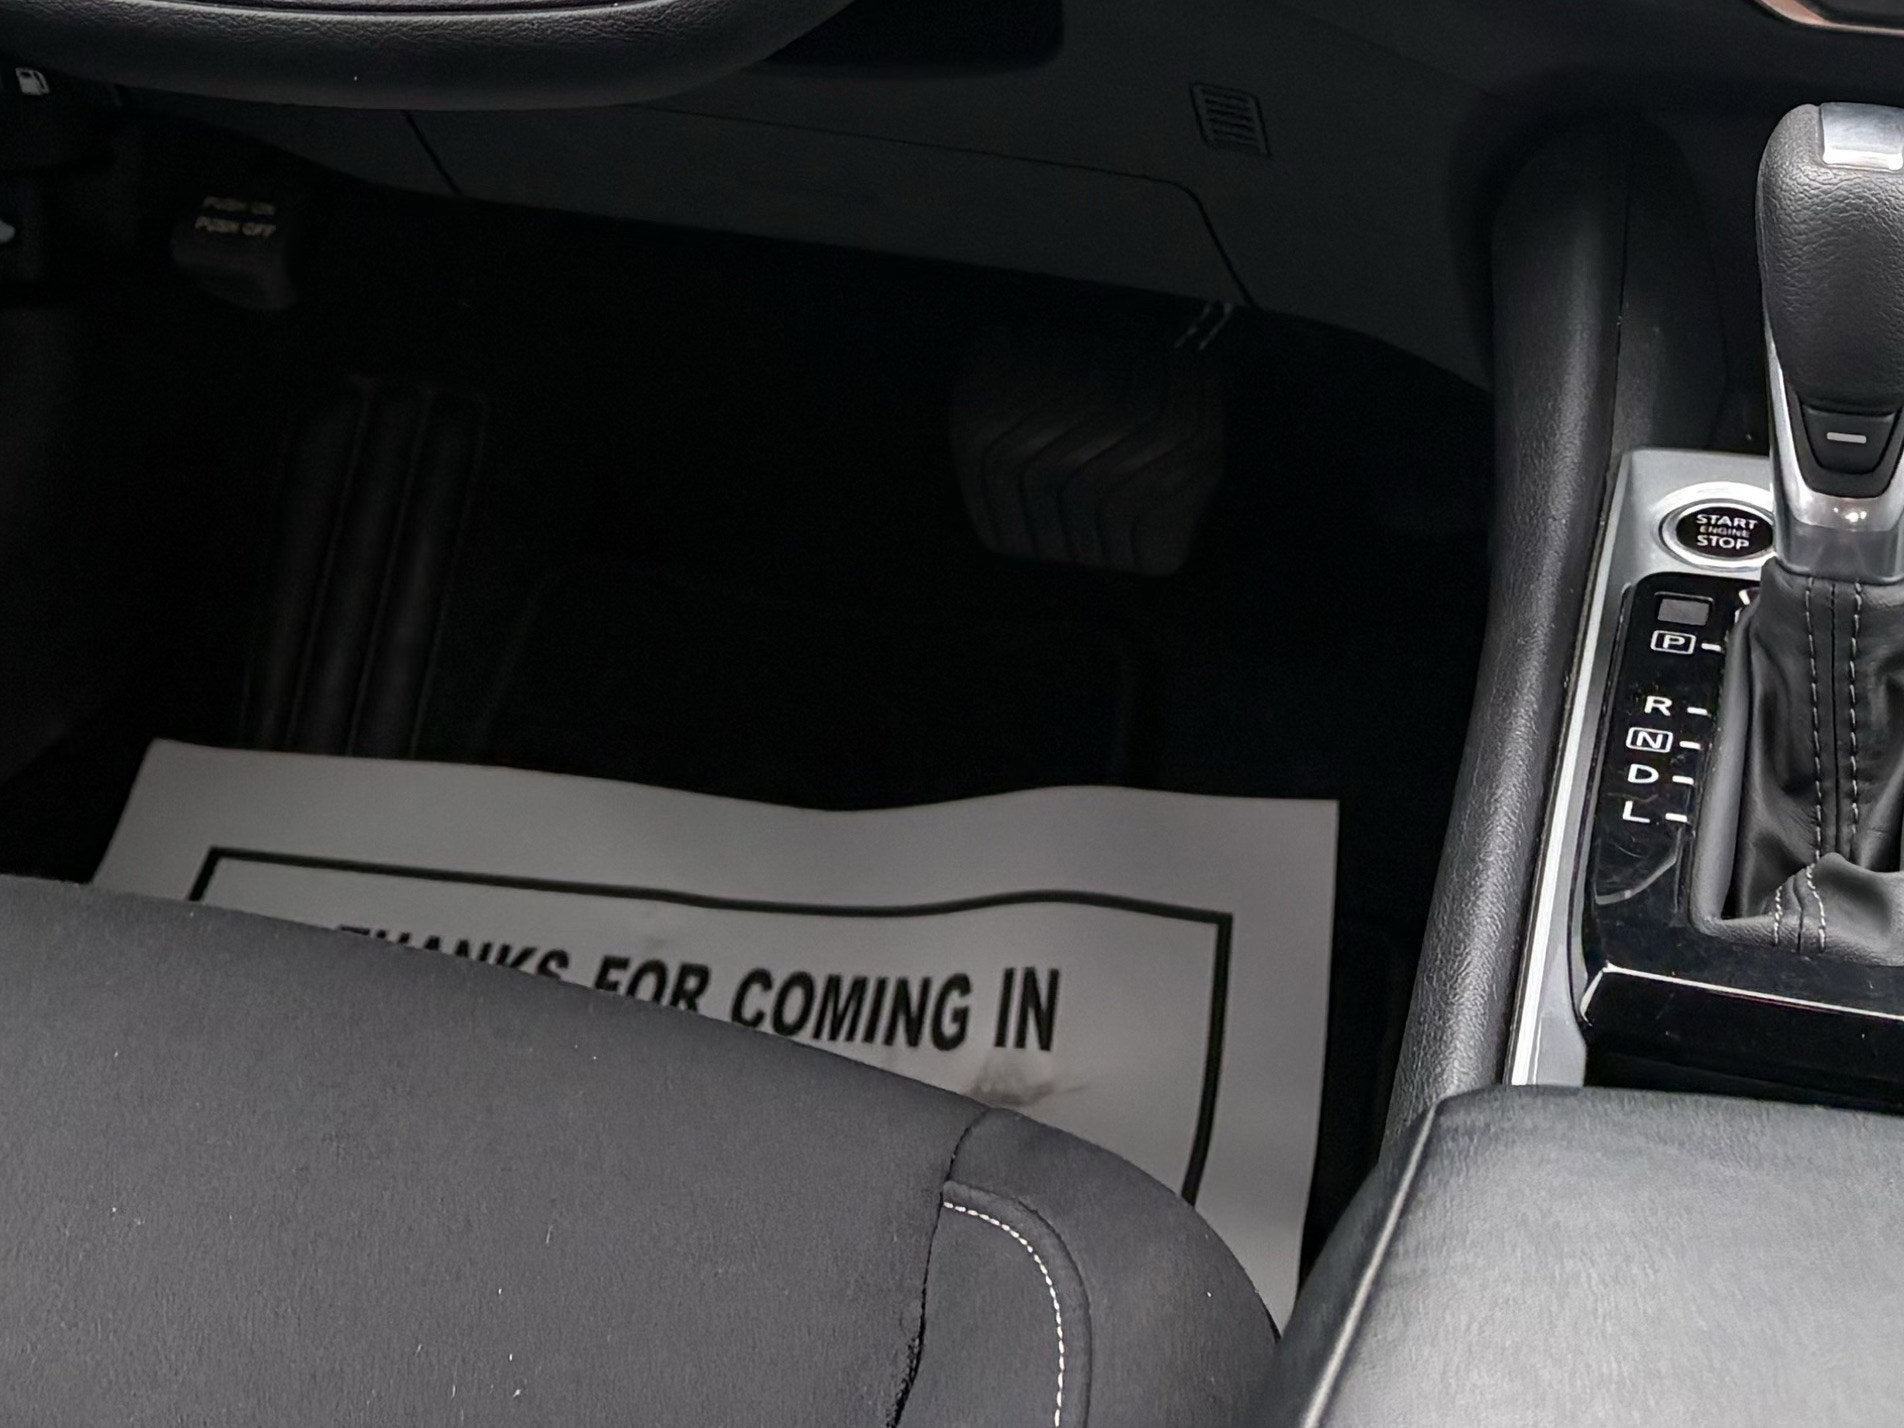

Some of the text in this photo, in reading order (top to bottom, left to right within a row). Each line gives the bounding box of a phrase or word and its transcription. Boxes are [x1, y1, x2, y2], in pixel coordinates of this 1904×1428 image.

[1696, 513, 1758, 530] START
[1699, 525, 1750, 538] ENGINE
[1696, 534, 1750, 550] STOP
[1661, 635, 1685, 651] P
[1645, 696, 1674, 716] R
[1636, 730, 1665, 748] N
[1628, 765, 1659, 784] D
[1622, 801, 1651, 822] L
[729, 969, 972, 1052] COMING
[994, 966, 1060, 1051] IN
